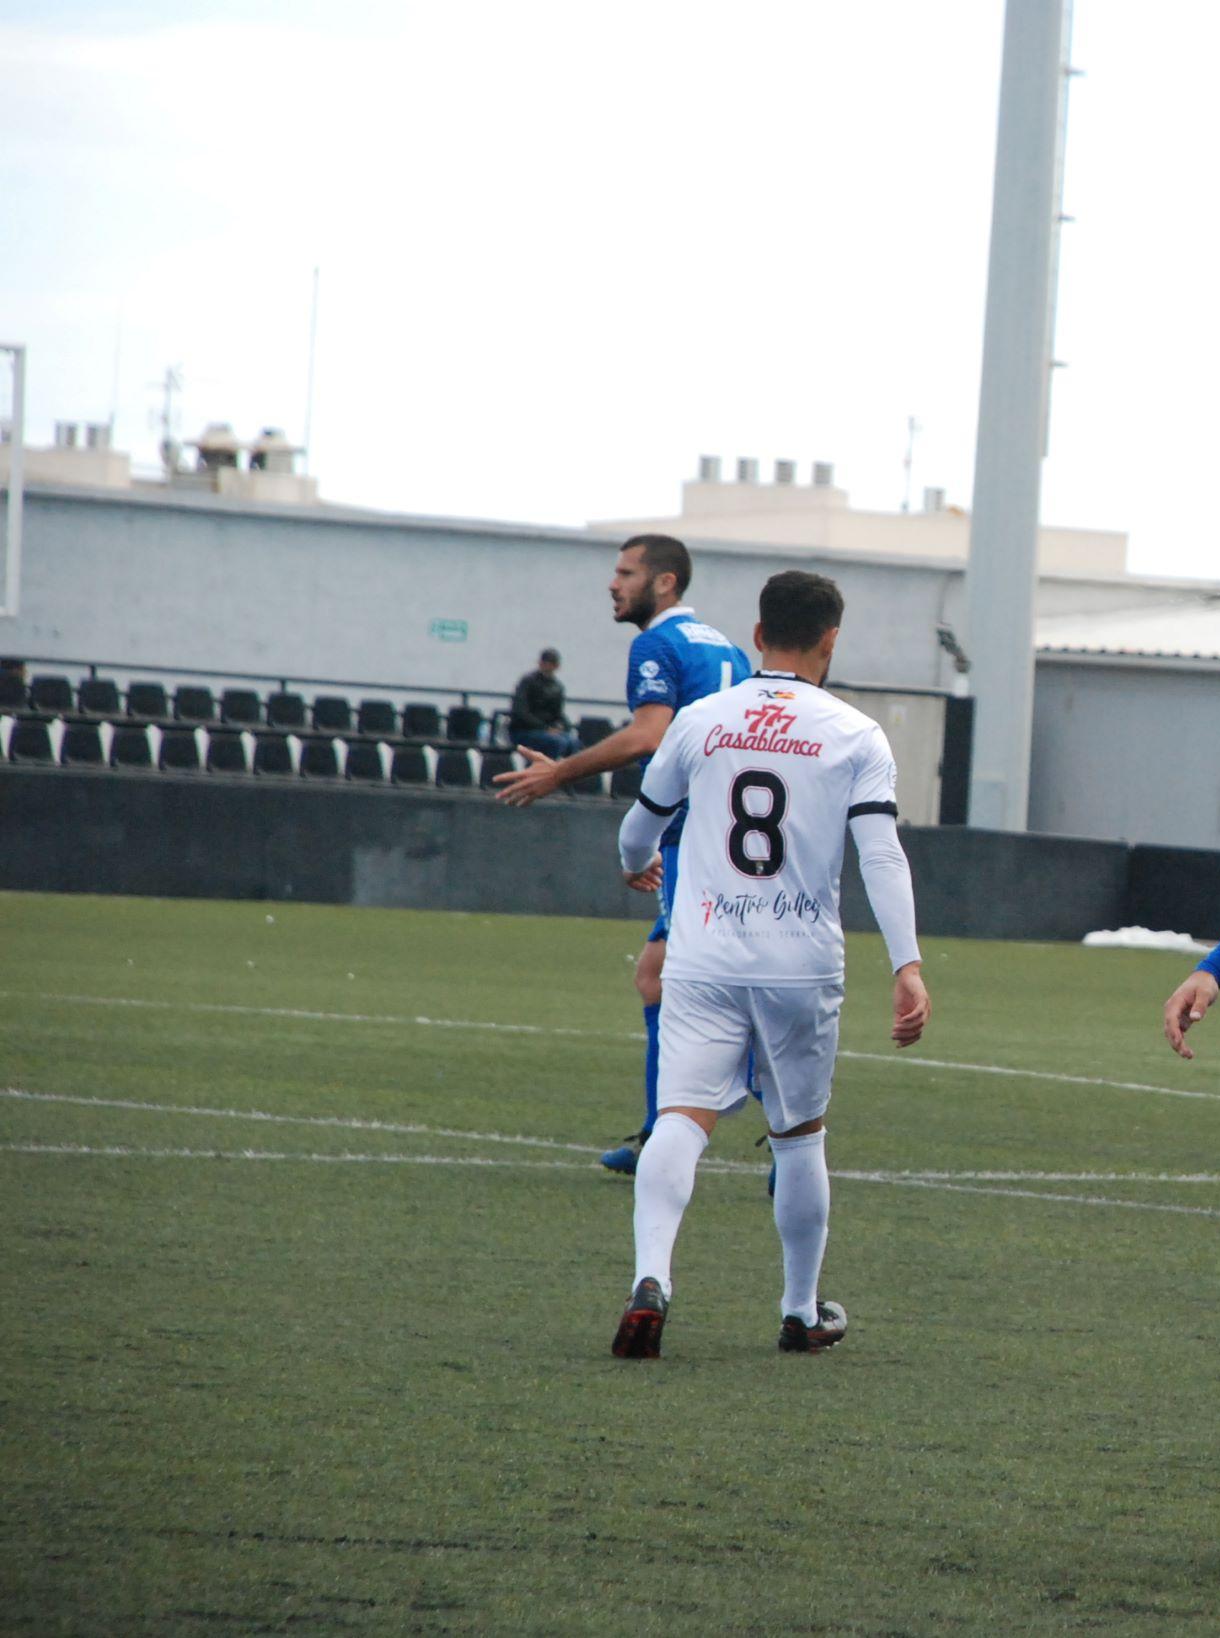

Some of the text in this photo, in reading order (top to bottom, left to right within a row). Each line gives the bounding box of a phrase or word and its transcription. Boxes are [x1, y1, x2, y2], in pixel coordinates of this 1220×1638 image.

[744, 703, 797, 734] 777
[703, 724, 823, 757] Casablanca
[726, 766, 790, 880] 8
